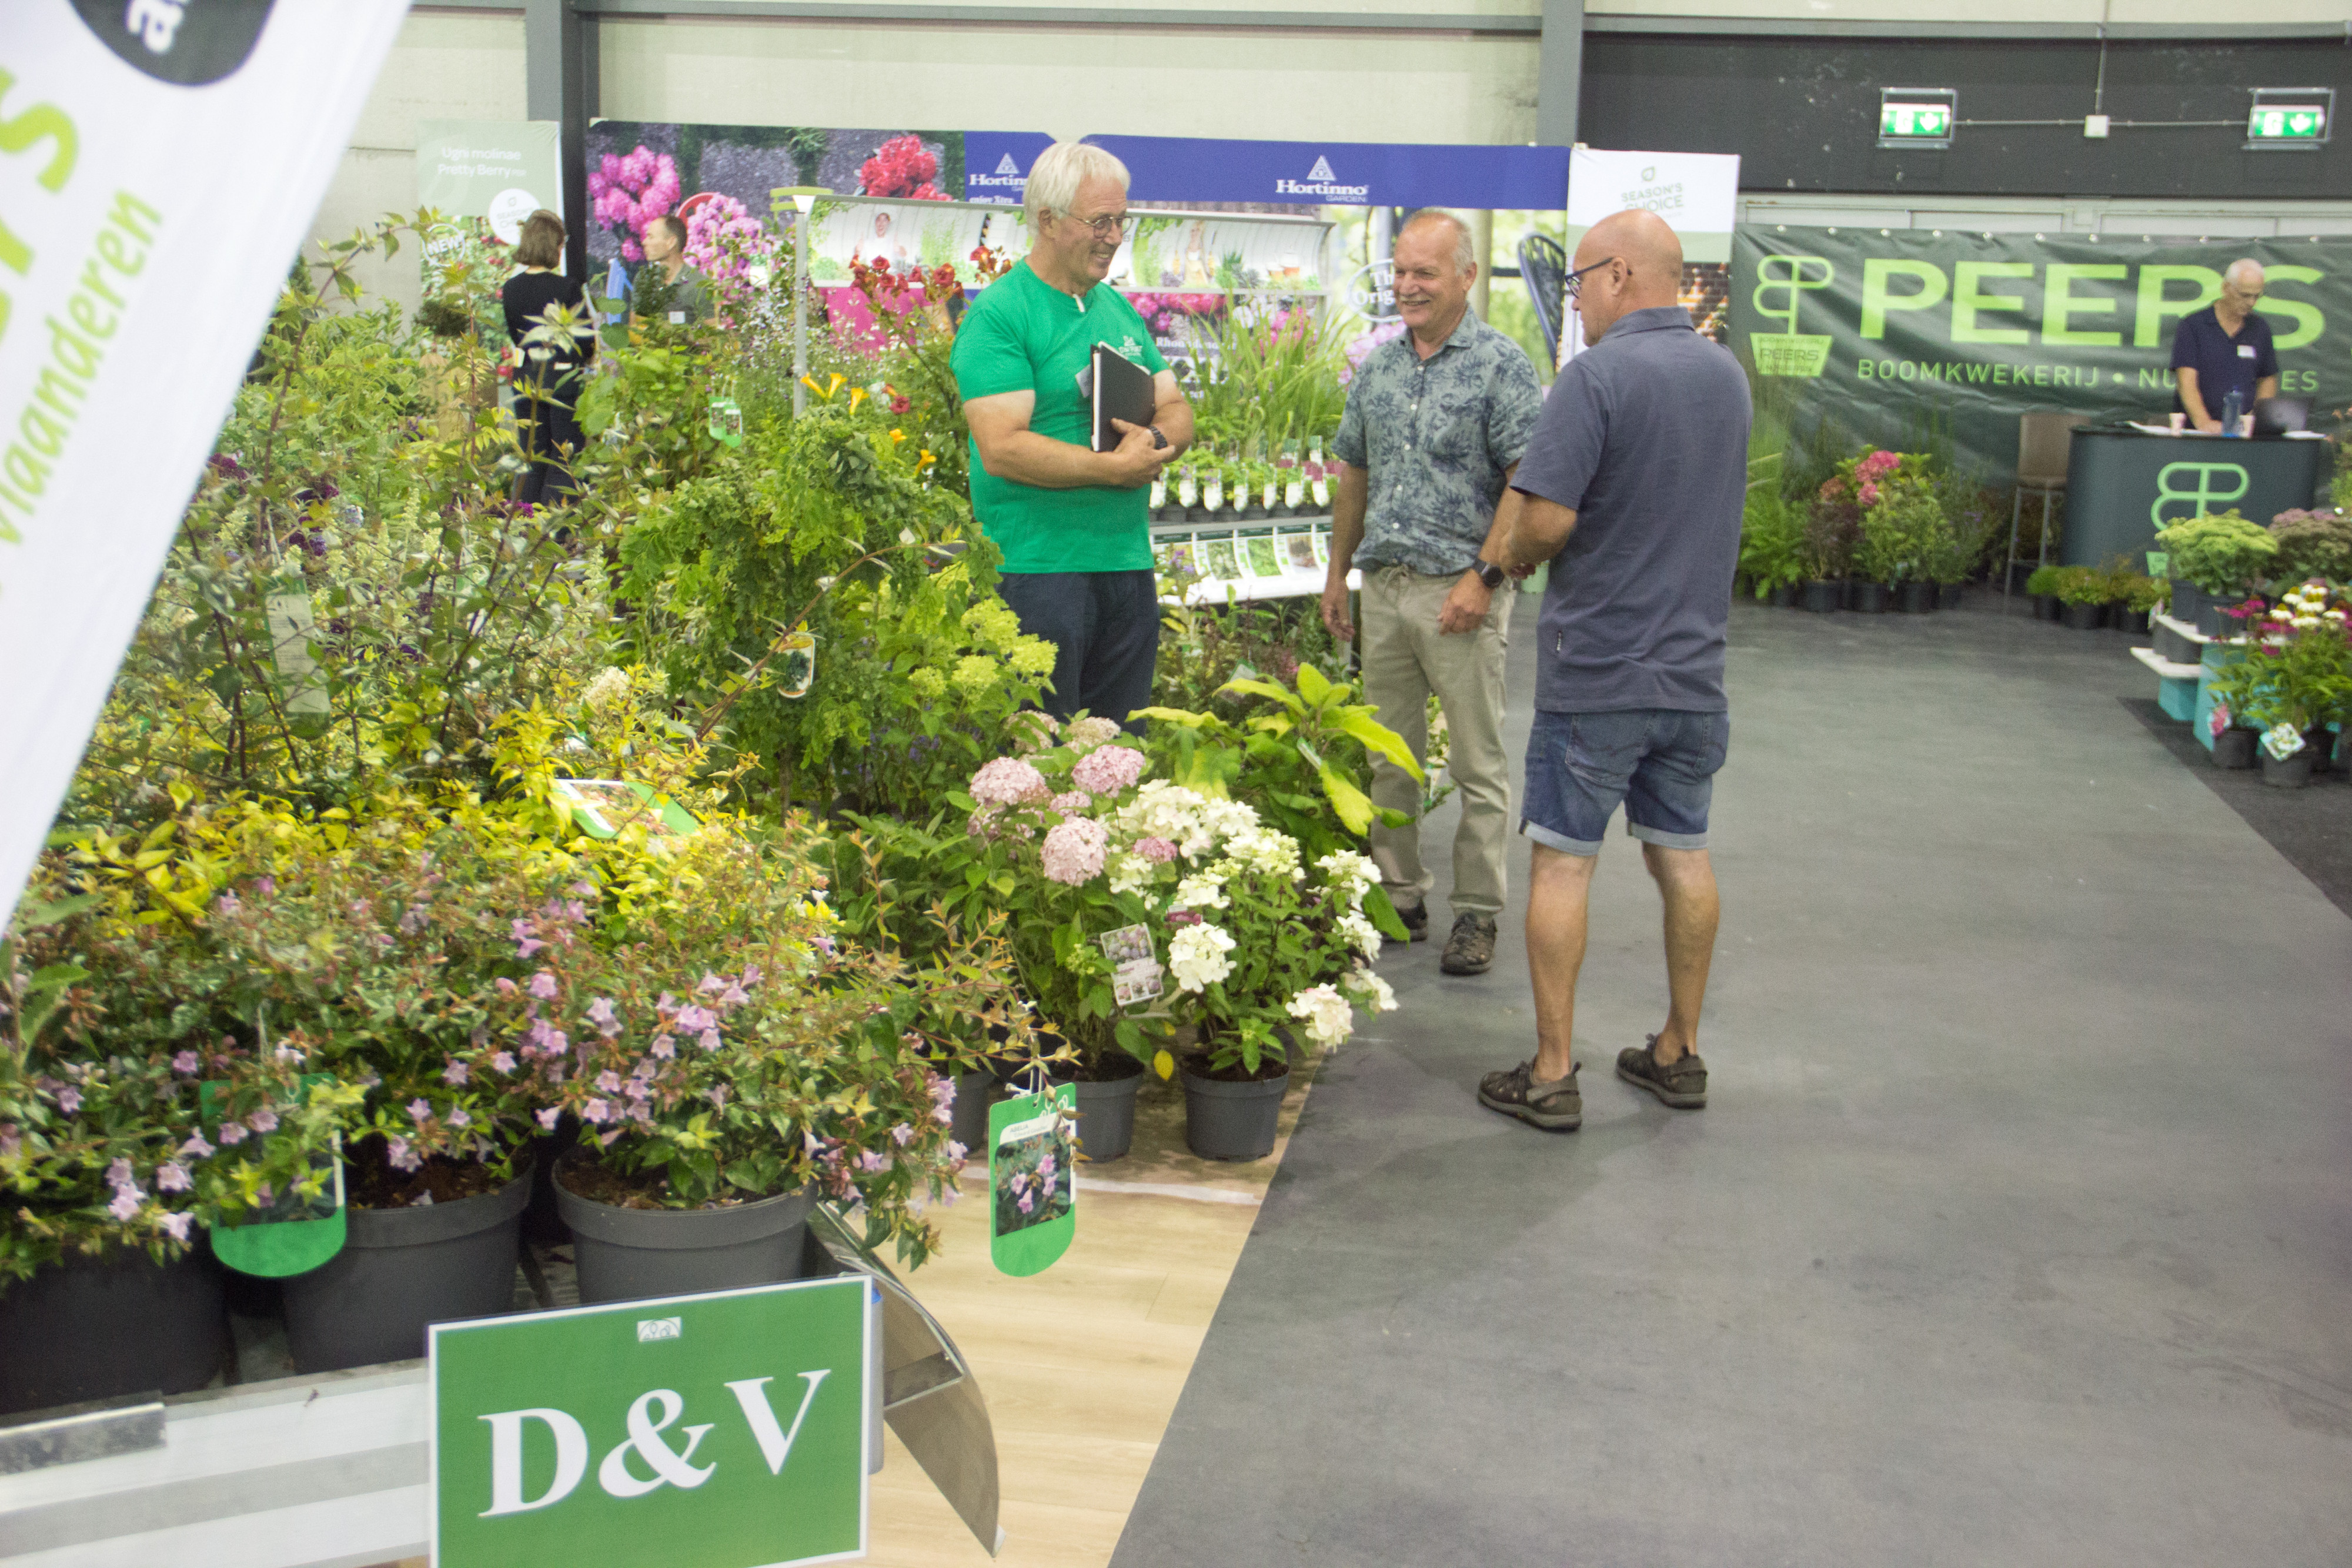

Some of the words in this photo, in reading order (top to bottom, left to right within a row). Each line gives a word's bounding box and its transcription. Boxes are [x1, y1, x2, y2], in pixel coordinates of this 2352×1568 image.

[442, 147, 469, 161] Ugni
[471, 148, 522, 161] molinae
[437, 163, 476, 178] Pretty
[477, 164, 511, 179] Berry
[969, 173, 1028, 186] Hortin
[1275, 179, 1367, 195] Hortinno
[1621, 182, 1683, 202] SEASON'S
[1370, 270, 1395, 287] Th
[1354, 287, 1395, 306] Orig
[1860, 258, 2327, 350] PEERS
[1760, 348, 1819, 360] PEERS
[1857, 359, 2100, 388] BOOMKWEKERIJ
[478, 1369, 831, 1517] D&V
